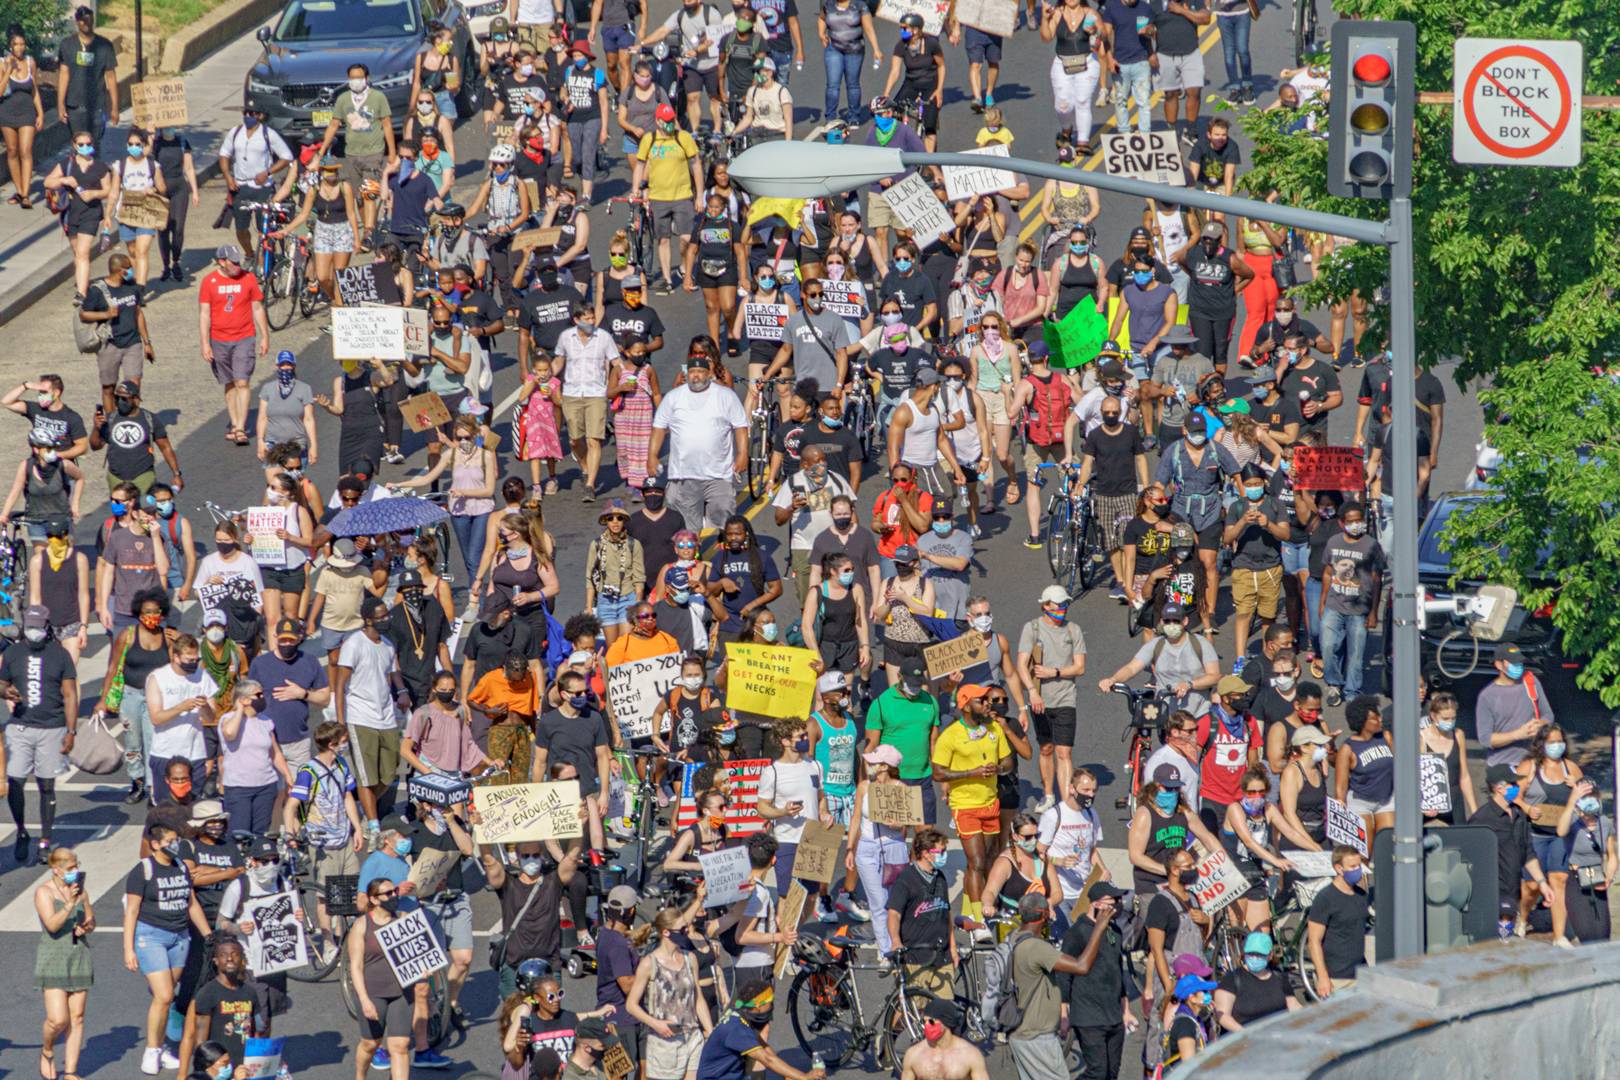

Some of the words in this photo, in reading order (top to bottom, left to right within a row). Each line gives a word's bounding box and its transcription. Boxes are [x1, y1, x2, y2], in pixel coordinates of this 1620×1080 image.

[1492, 67, 1540, 80] DON'T
[1482, 85, 1549, 98] BLOCK
[1501, 106, 1530, 117] THE
[494, 126, 512, 136] JUS
[1500, 126, 1530, 138] BOX
[1110, 134, 1163, 154] GOD
[1109, 153, 1179, 173] SAVES
[953, 169, 1003, 194] MATTER
[887, 175, 924, 206] BLACK
[898, 191, 938, 222] LIVES
[336, 265, 374, 283] LOVE
[339, 278, 376, 294] BLACK
[823, 281, 852, 291] LACK
[343, 289, 378, 303] PEOPLE
[747, 304, 780, 315] BLACK
[612, 319, 644, 333] 8:46
[748, 315, 778, 326] LIVES
[748, 327, 781, 338] MATTE
[1299, 455, 1353, 464] RACISM
[250, 518, 282, 529] MATTER
[926, 647, 954, 661] BLACK
[959, 633, 984, 653] LIVES
[736, 648, 752, 656] WE
[762, 651, 793, 662] CANT
[27, 655, 42, 680] JUST
[634, 663, 652, 674] Do
[656, 655, 682, 670] YOU
[746, 658, 790, 674] BREATHE
[934, 653, 966, 672] MATTER
[733, 669, 751, 680] GET
[756, 673, 775, 683] OFF
[779, 677, 798, 689] OUR
[611, 683, 632, 696] ATE
[745, 682, 777, 696] NECKS
[613, 689, 641, 706] esent
[617, 705, 639, 717] ILL
[828, 735, 855, 746] GOOD
[1359, 744, 1394, 767] HOWARD
[829, 772, 851, 781] VIBE
[410, 782, 445, 804] DEFUND
[448, 789, 469, 804] NOW
[486, 786, 530, 807] ENOUGH
[876, 786, 914, 800] BLACK
[512, 789, 561, 826] ENOUGH!
[515, 797, 527, 808] IS
[879, 798, 911, 811] LIVES
[1330, 812, 1358, 837] LIVES
[1197, 850, 1226, 878] UND
[157, 875, 189, 889] BLACK
[159, 888, 190, 901] LIVES
[272, 929, 289, 937] LIVES
[380, 913, 426, 947] BLACK
[274, 934, 298, 943] MATTER
[394, 934, 430, 963] LIVES
[397, 950, 444, 983] MATTER
[532, 1036, 575, 1053] STAY
